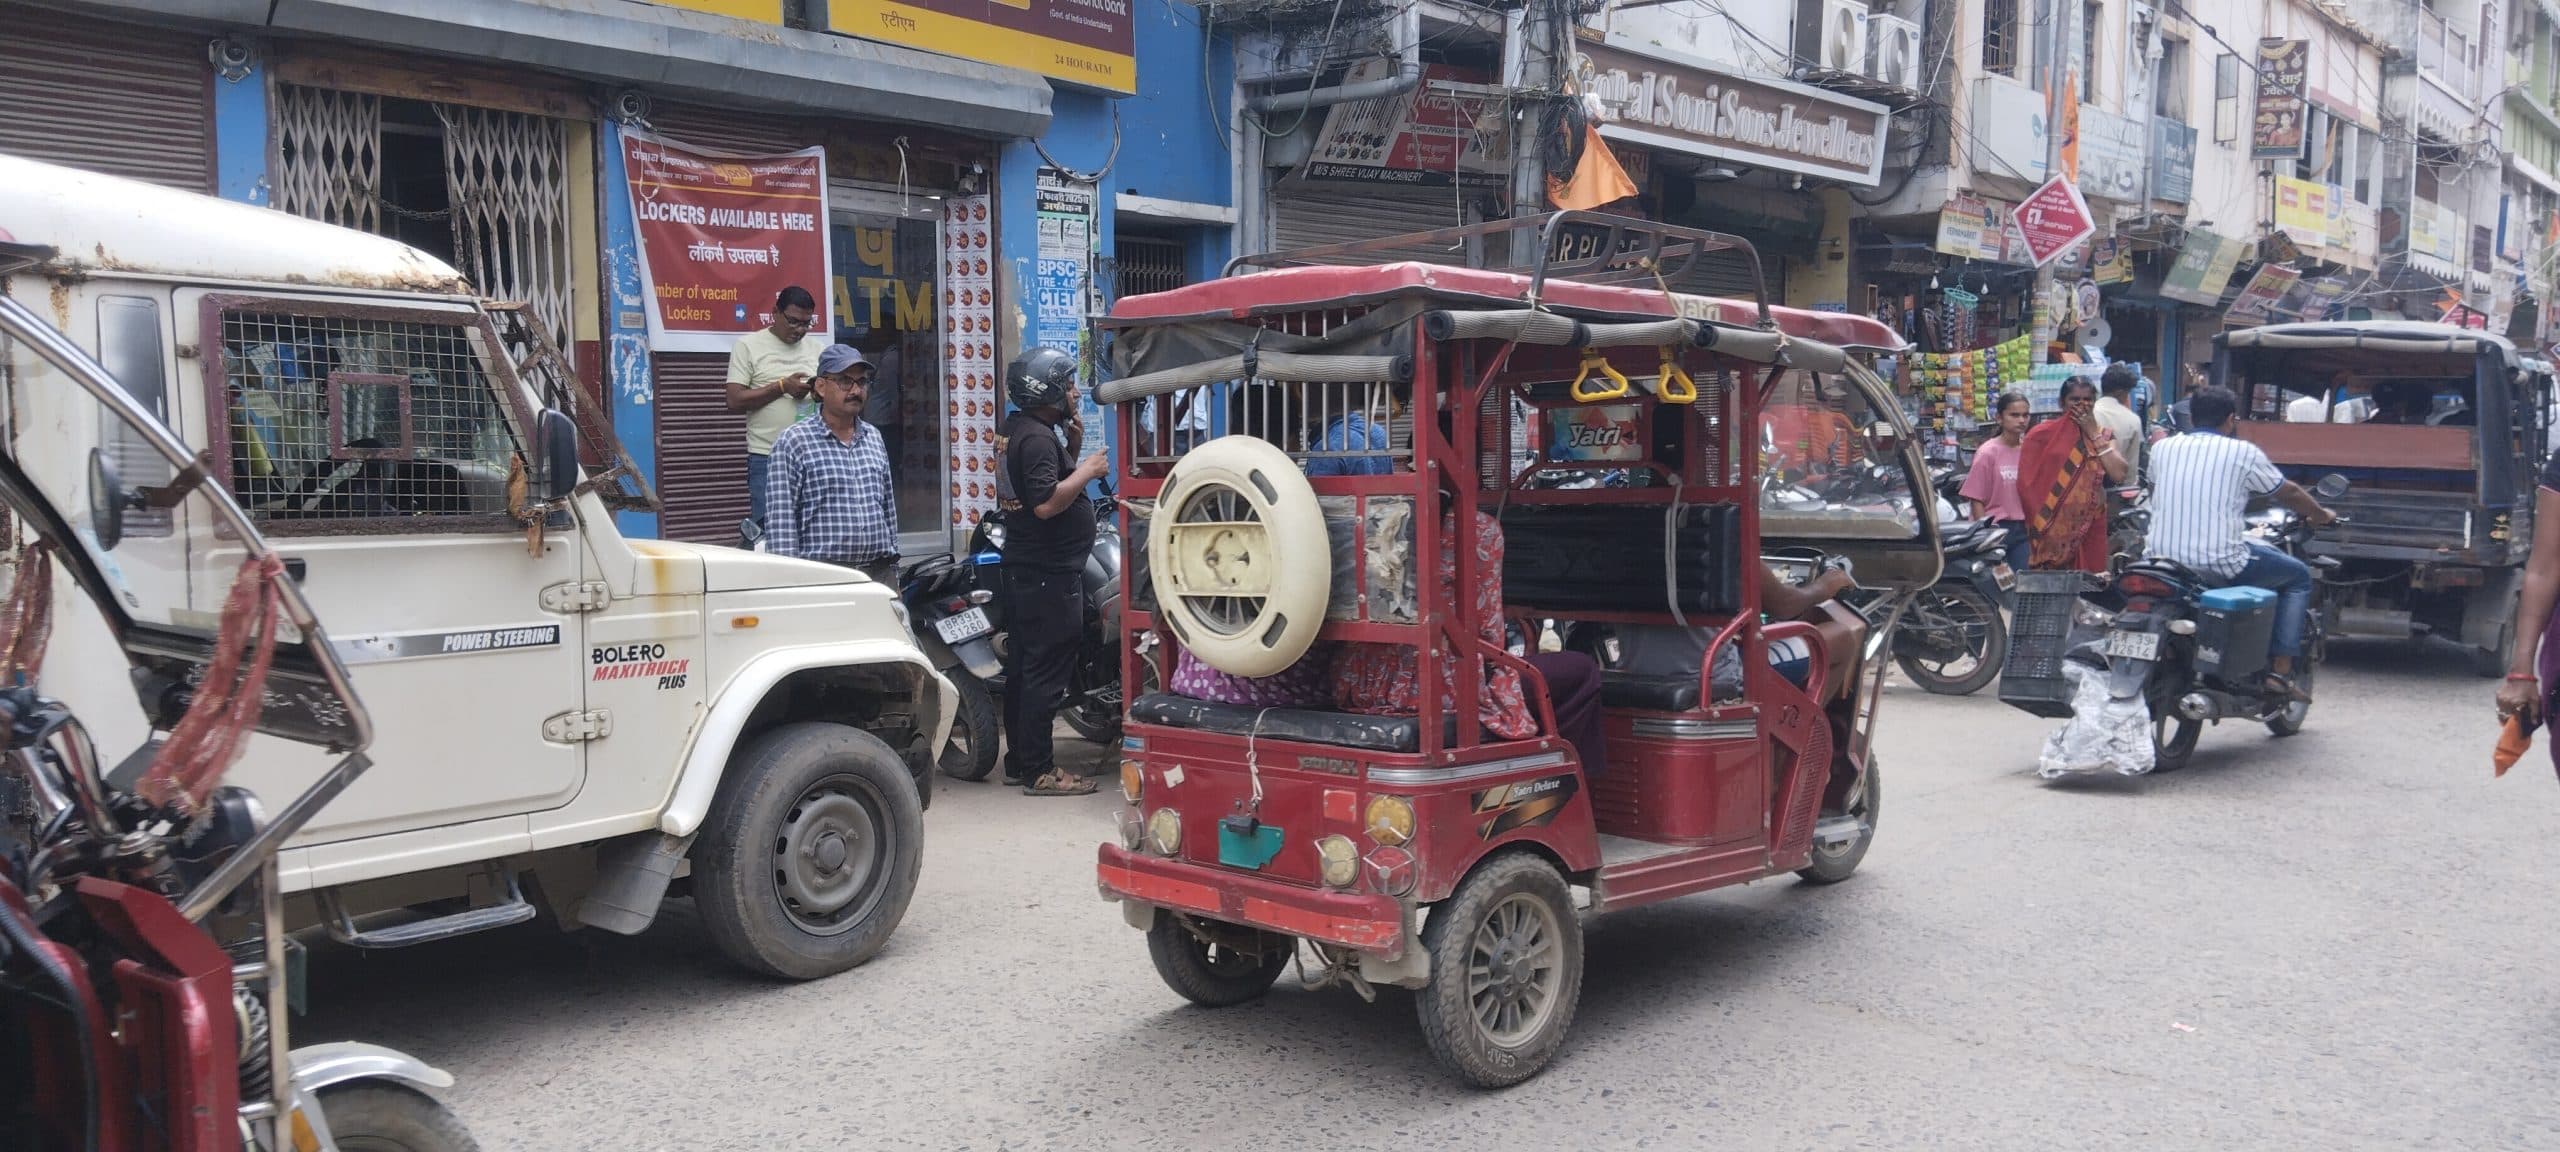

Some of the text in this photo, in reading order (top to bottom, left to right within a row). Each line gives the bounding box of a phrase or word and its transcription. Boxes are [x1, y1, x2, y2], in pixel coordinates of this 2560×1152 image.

[880, 11, 916, 32] एटीएम
[1054, 53, 1064, 66] 24
[1657, 75, 1717, 138] Soni
[1717, 89, 1777, 148] Sons
[1776, 103, 1876, 168] Jewellers
[1329, 165, 1358, 180] SHREE
[1358, 168, 1380, 181] VIJAY
[1380, 170, 1424, 183] MACHINERY
[639, 201, 815, 231] LOCKERS AVAILABLE HERE
[688, 240, 781, 267] लॉकर्स उपलब्ध है
[1037, 260, 1075, 277] BPSC
[1037, 277, 1056, 287] TRE
[1062, 278, 1075, 288] 4.0
[687, 284, 699, 299] of
[700, 287, 738, 301] vacant
[1039, 289, 1075, 306] CTET
[667, 305, 711, 321] Lockers
[832, 276, 933, 331] ATM
[1569, 423, 1622, 447] Yatri
[443, 627, 555, 652] POWER STEERING
[592, 643, 665, 664] BOLERO
[592, 659, 690, 681] MAXITRUCK
[657, 675, 687, 689] PLUS
[1534, 779, 1561, 793] Deluxe
